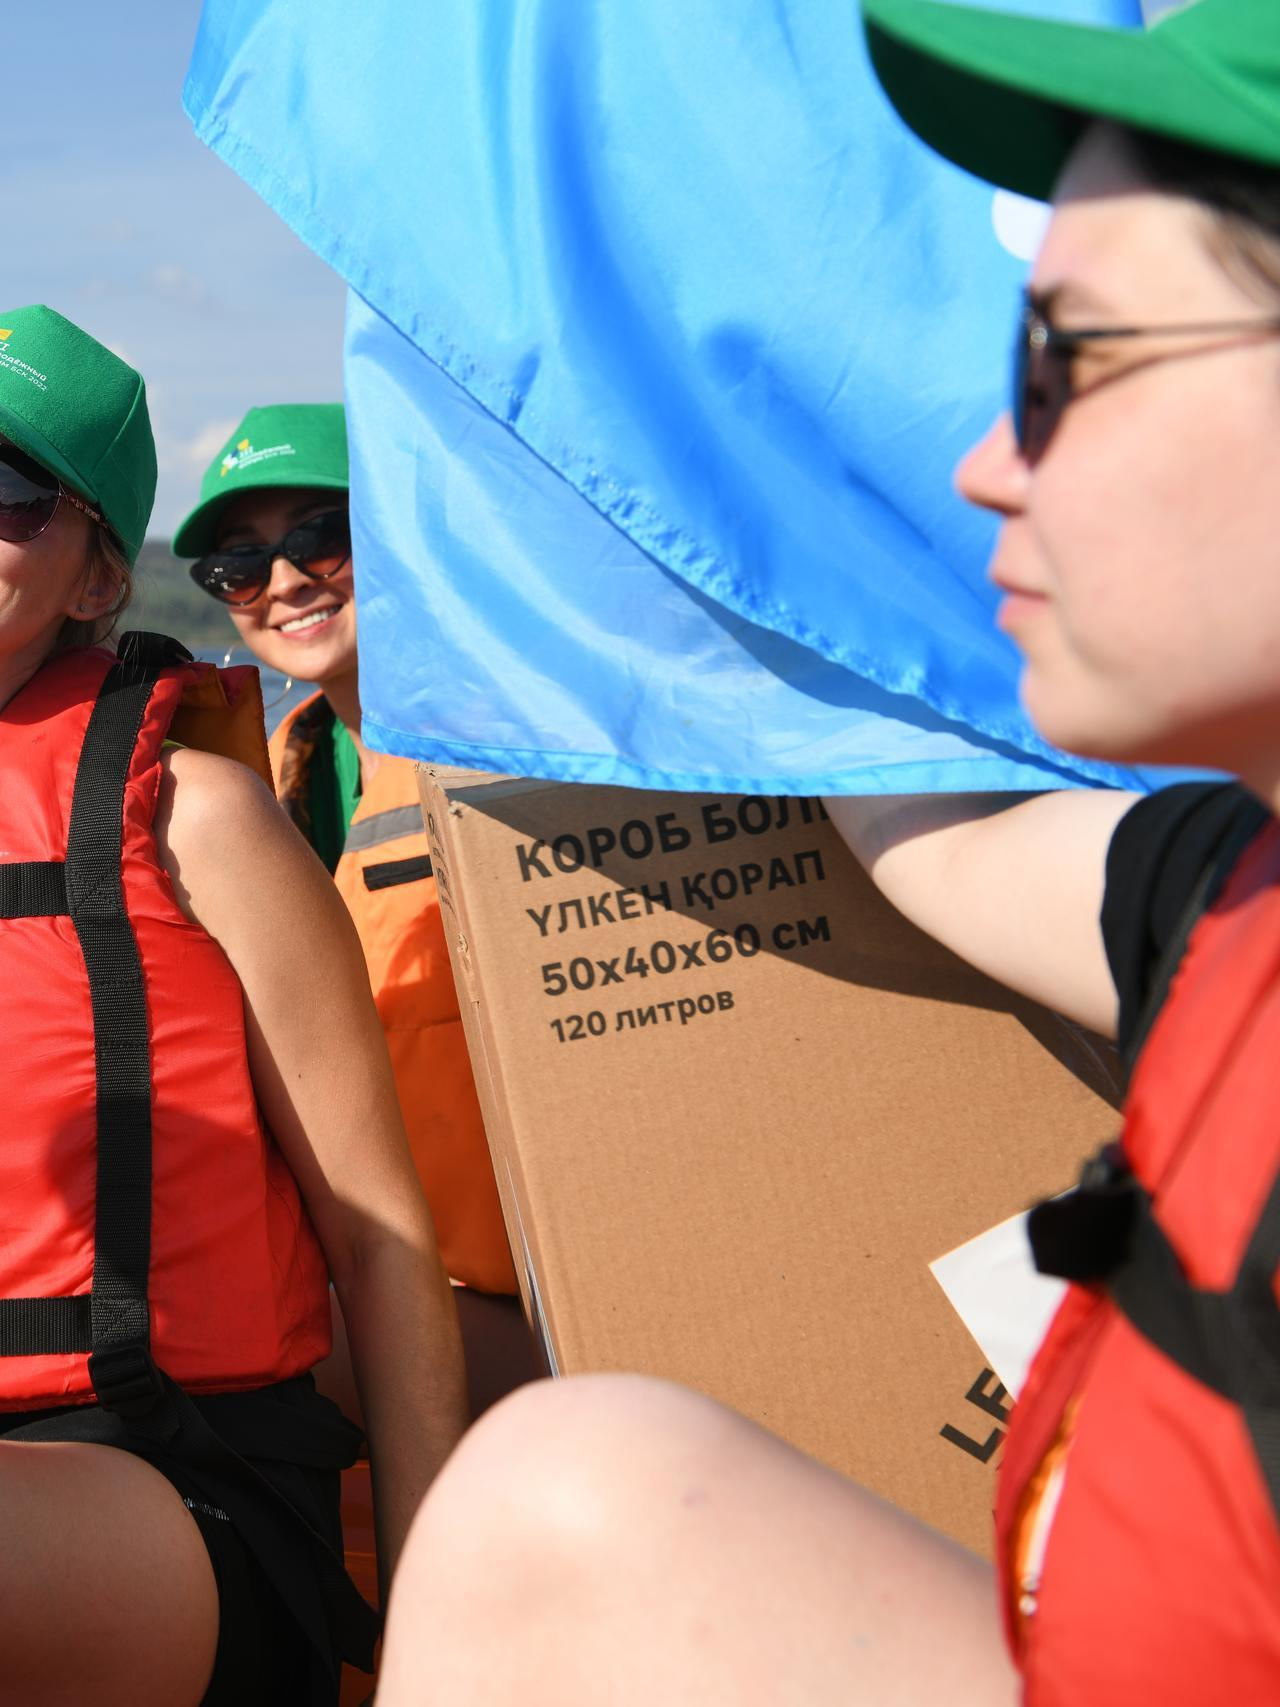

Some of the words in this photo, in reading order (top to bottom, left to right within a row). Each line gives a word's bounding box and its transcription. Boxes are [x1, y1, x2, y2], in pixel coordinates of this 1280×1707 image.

[515, 812, 691, 882] КОРОБ
[701, 795, 829, 844] БОЛ
[681, 849, 826, 911] ҚОРАП
[772, 915, 831, 951] см
[550, 1010, 607, 1043] 120
[615, 990, 735, 1032] литров
